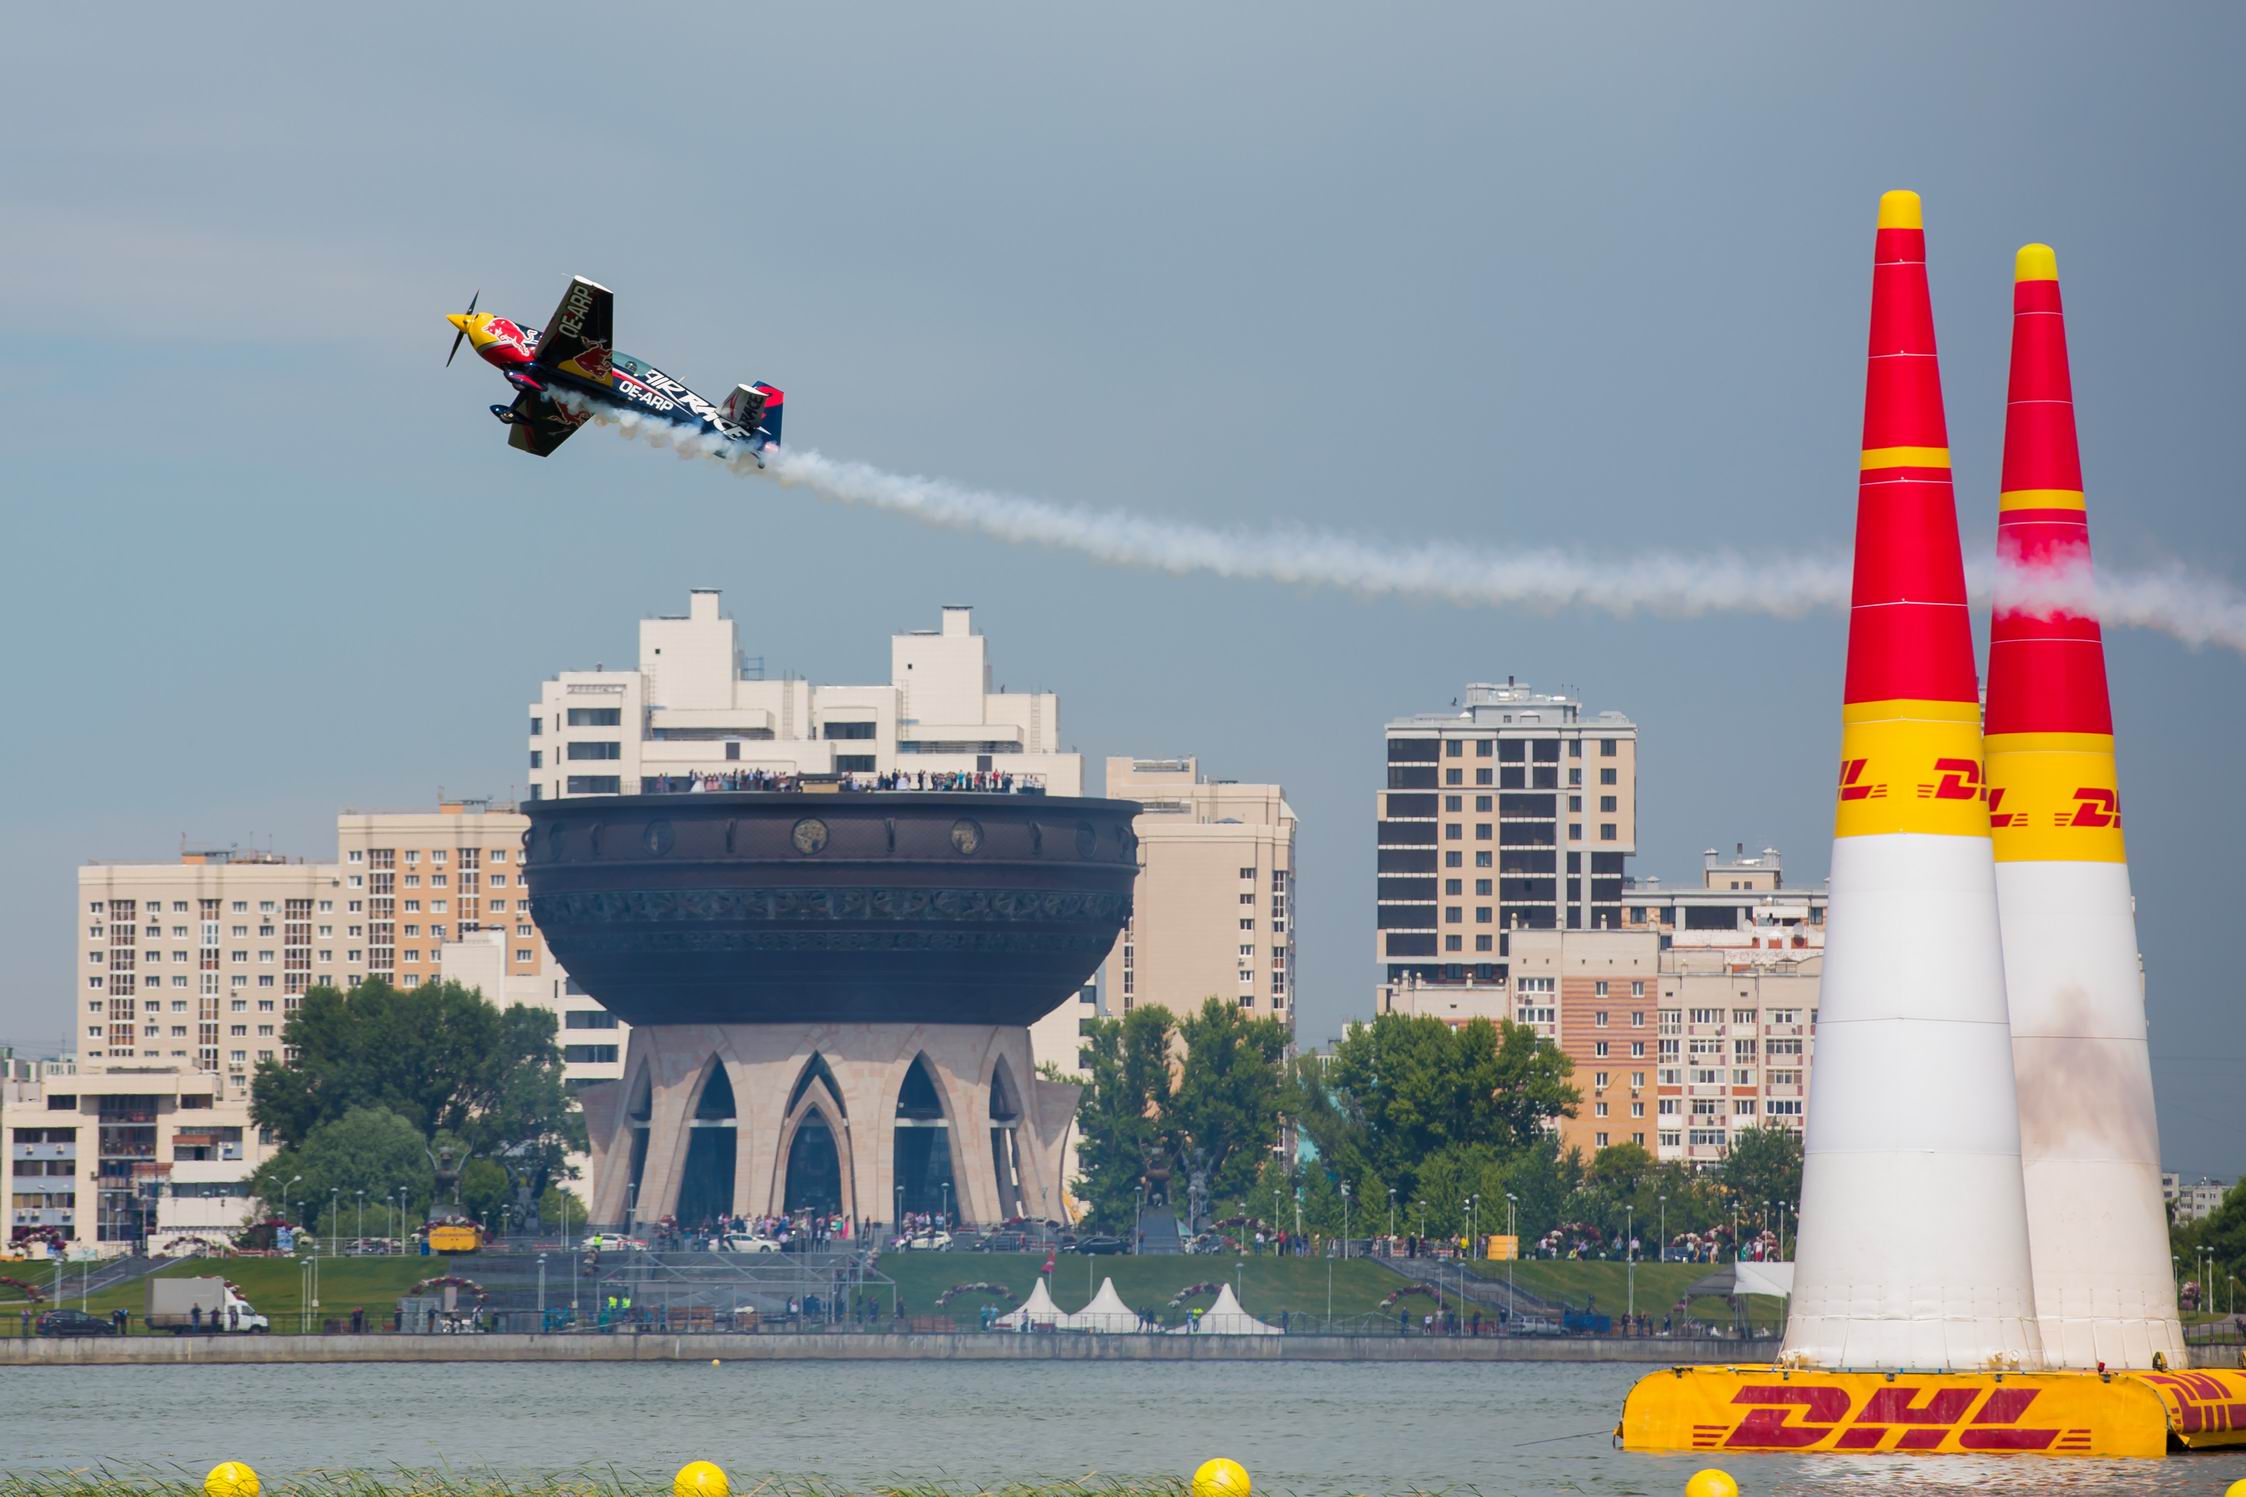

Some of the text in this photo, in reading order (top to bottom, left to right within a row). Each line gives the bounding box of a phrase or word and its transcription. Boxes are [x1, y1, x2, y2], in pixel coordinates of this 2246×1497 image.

[559, 285, 592, 338] OE-ARP
[619, 380, 674, 412] OE-ARP
[645, 368, 686, 406] AIR
[1723, 1385, 2062, 1451] DHL
